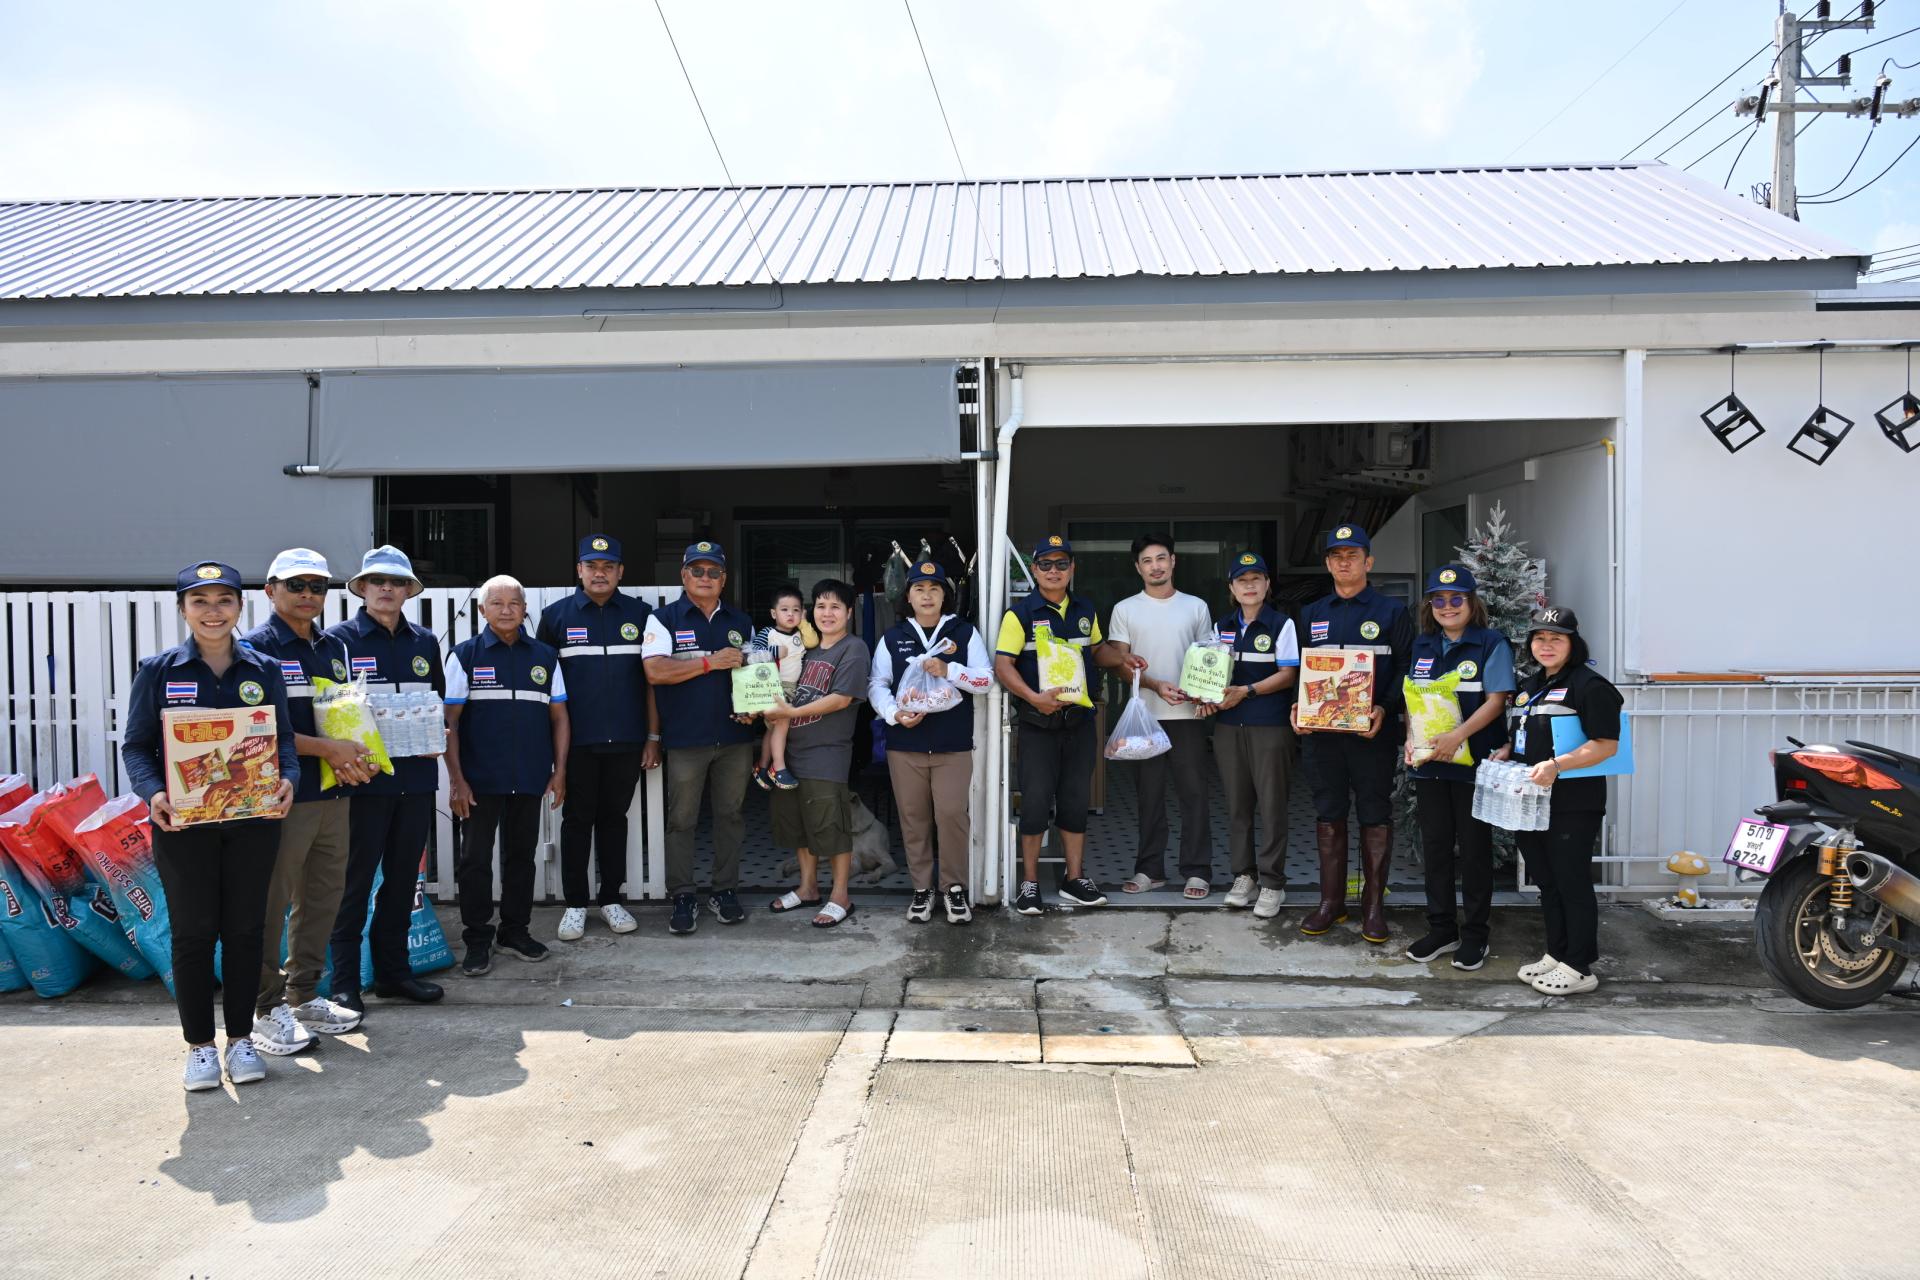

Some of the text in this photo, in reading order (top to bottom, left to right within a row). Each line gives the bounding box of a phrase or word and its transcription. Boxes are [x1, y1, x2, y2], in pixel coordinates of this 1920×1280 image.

[174, 723, 228, 743] ไวไว
[120, 830, 146, 850] 550
[1732, 850, 1767, 867] 9724
